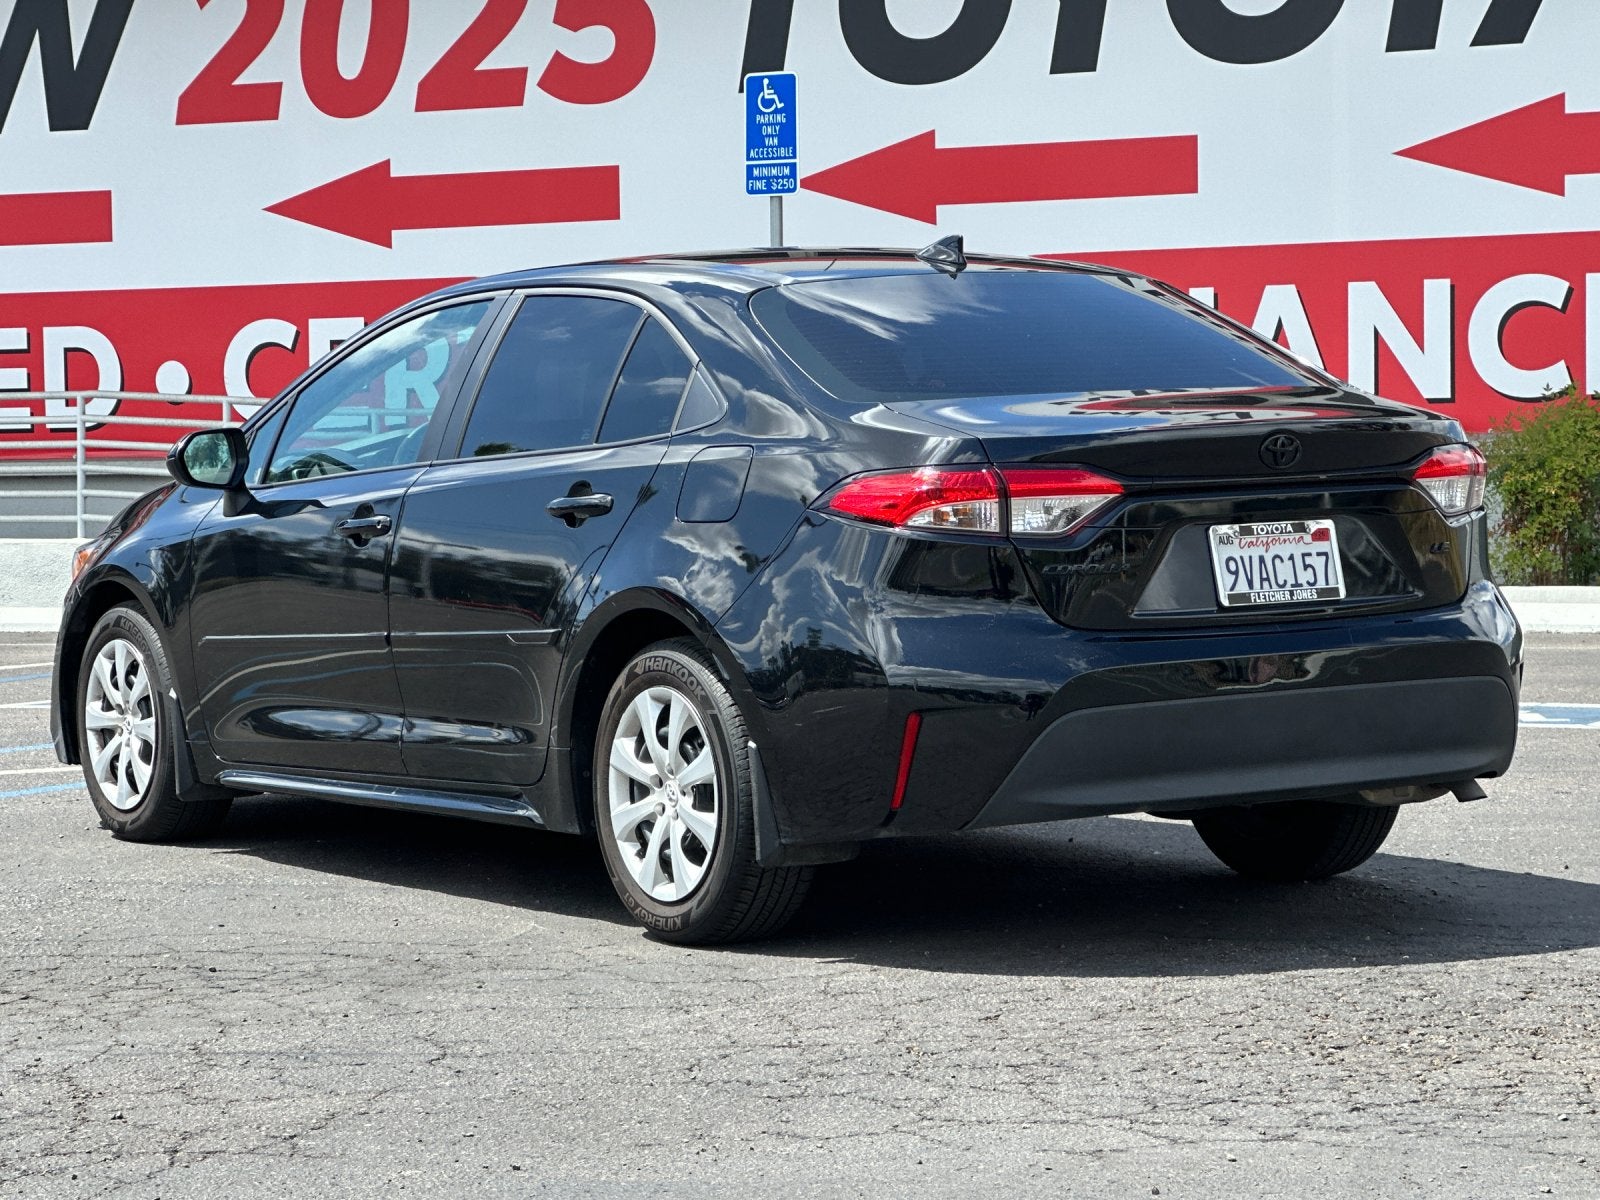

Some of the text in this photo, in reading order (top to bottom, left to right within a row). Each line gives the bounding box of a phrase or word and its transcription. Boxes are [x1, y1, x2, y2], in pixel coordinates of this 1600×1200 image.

[756, 113, 786, 124] PARKING
[762, 125, 780, 135] ONLY
[764, 137, 778, 146] VAN
[749, 147, 793, 158] ACCESSIBLE
[753, 166, 790, 177] MINIMUM
[748, 179, 794, 190] FINE $250
[1251, 523, 1294, 535] TOYOTA
[1218, 535, 1234, 545] AUG
[1238, 534, 1313, 553] California
[1224, 551, 1330, 592] 9VAC157
[1250, 589, 1318, 603] FLETCHER JONES
